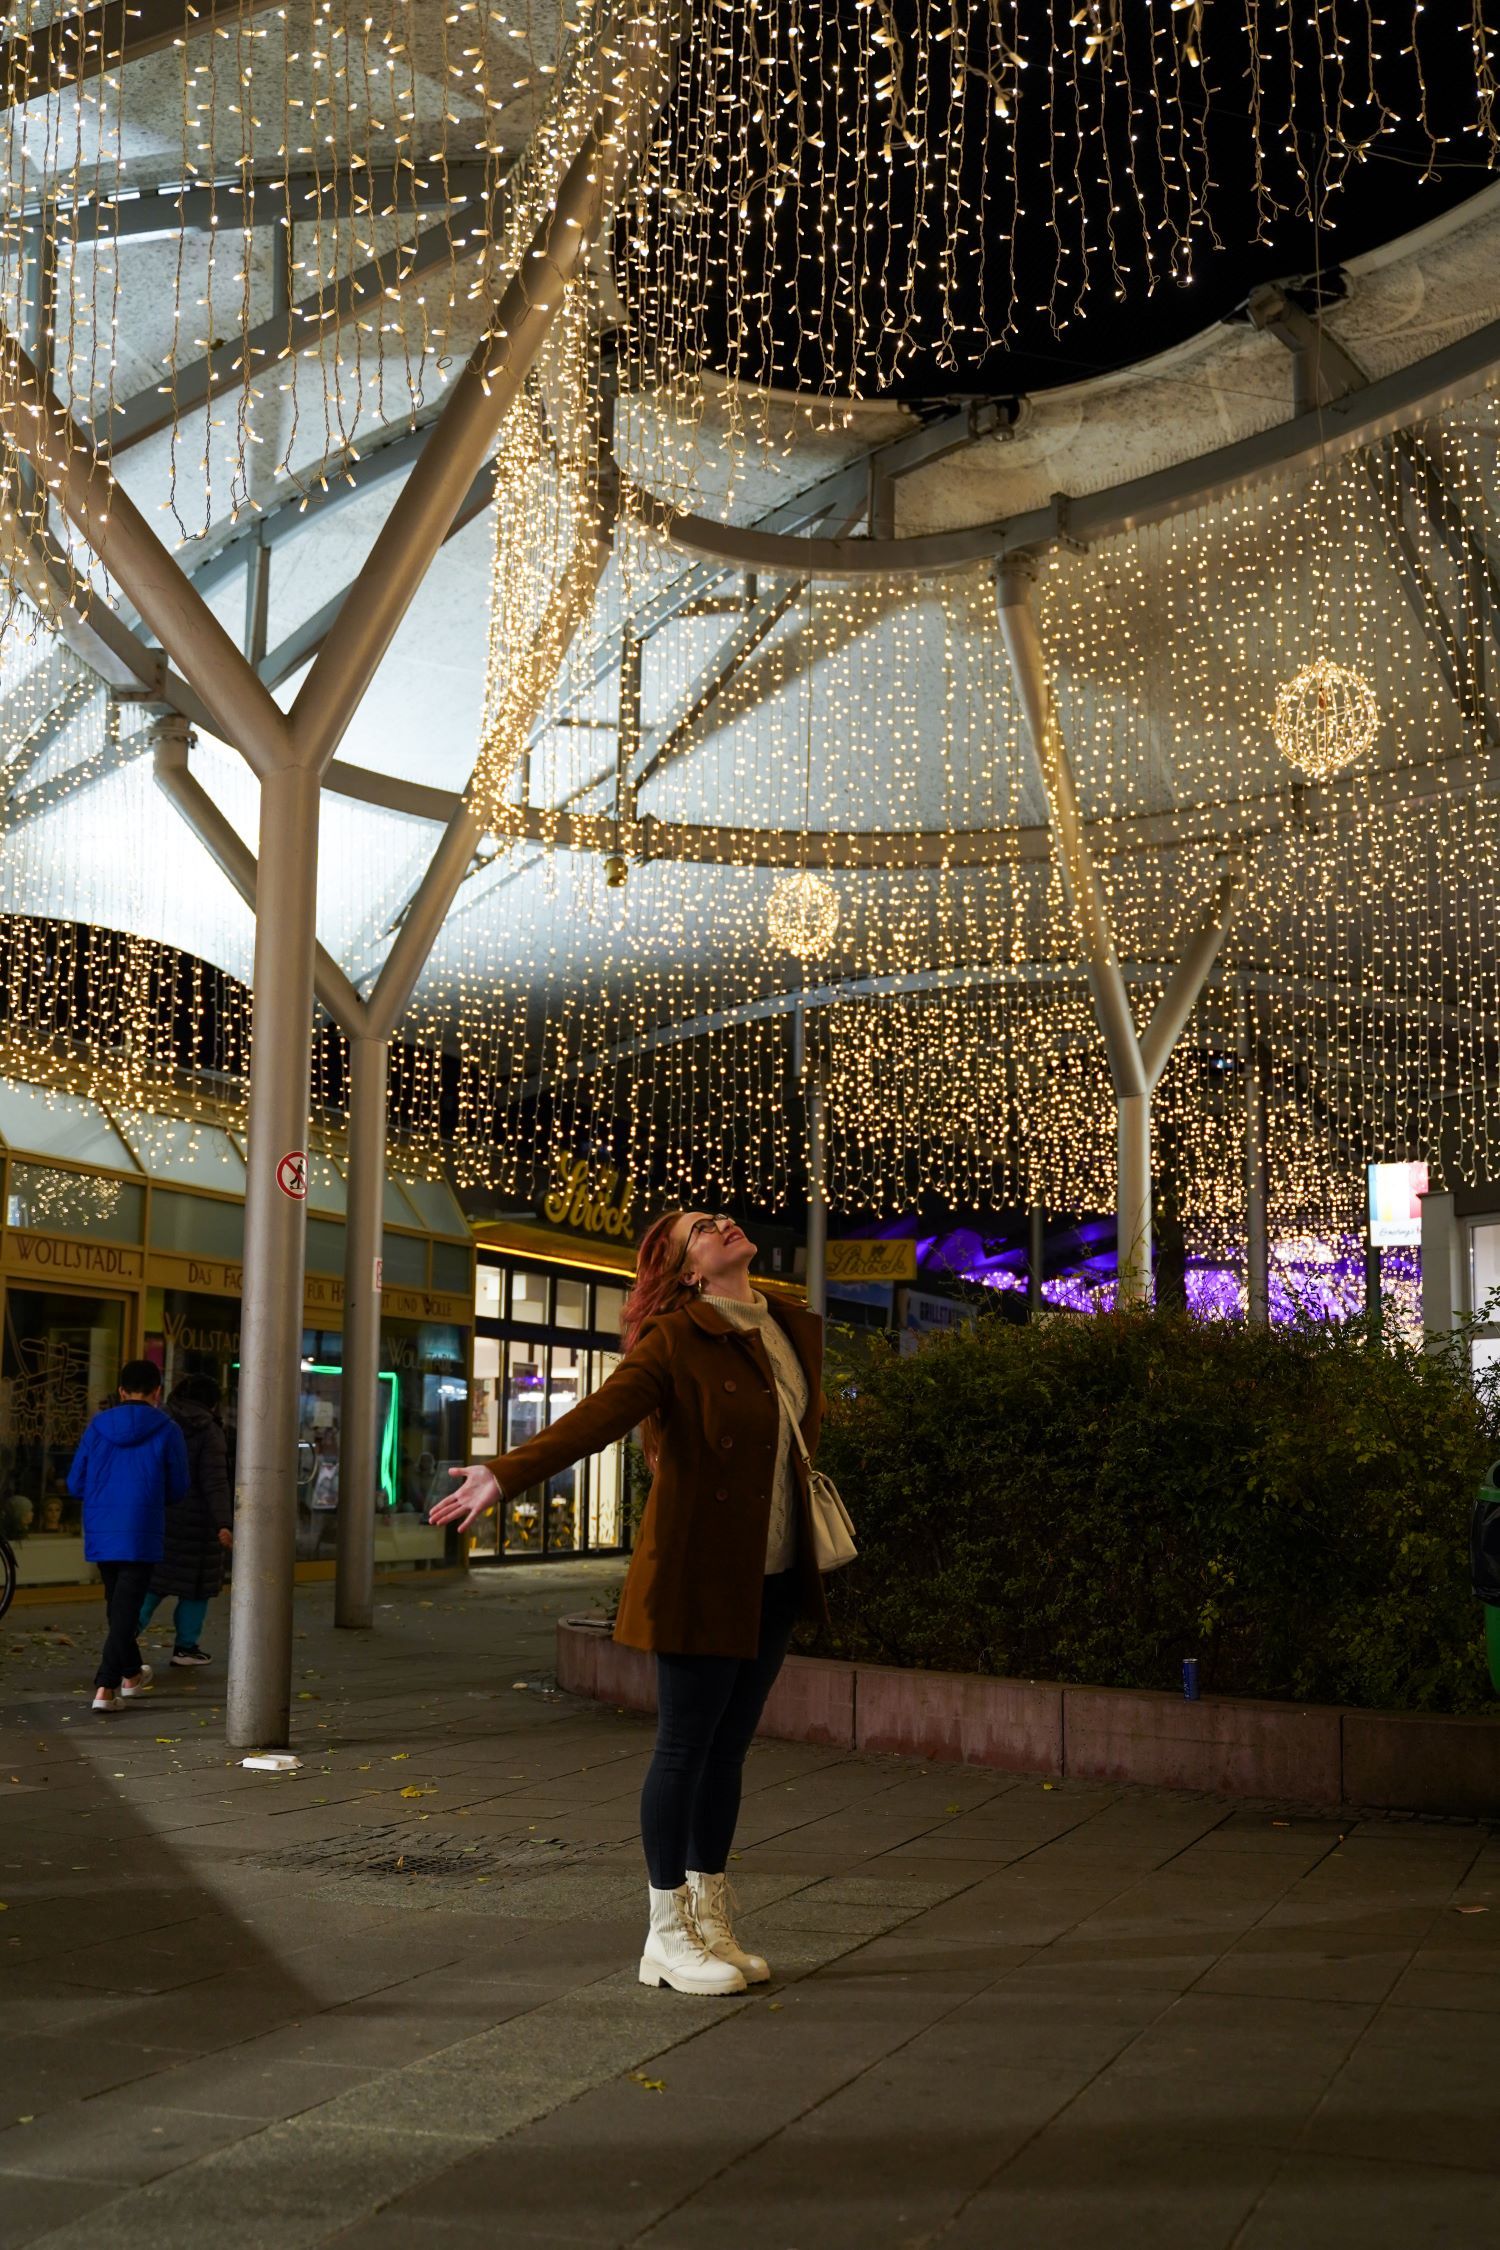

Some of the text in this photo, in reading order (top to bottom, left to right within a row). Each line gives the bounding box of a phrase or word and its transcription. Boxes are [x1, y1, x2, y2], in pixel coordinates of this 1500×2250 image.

[544, 1151, 634, 1240] Ströck
[826, 1244, 908, 1276] Ströck
[163, 1311, 241, 1354] WOLLSTAD
